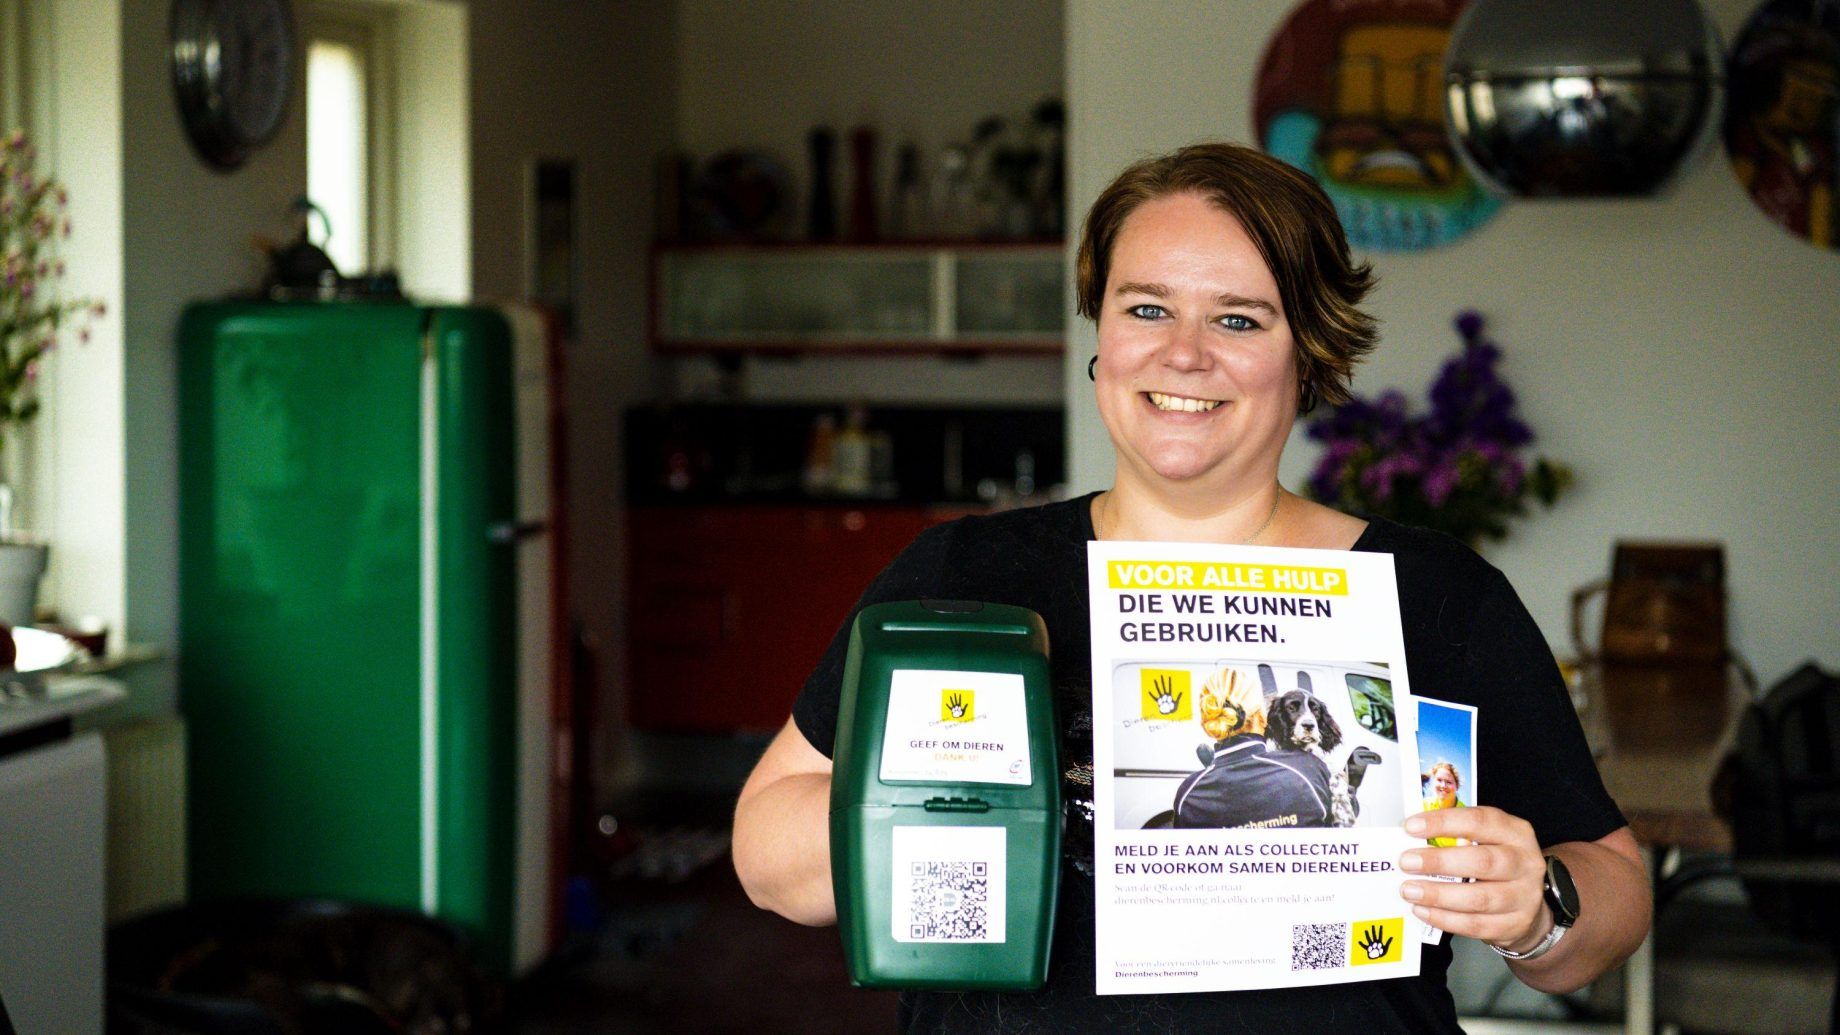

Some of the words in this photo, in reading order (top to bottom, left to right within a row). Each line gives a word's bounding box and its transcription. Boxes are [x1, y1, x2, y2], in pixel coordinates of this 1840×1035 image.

[1115, 564, 1194, 586] VOOR
[1202, 566, 1265, 588] ALLE
[1273, 569, 1340, 591] HULP
[1118, 593, 1163, 613] DIE
[1172, 594, 1215, 614] WE
[1224, 595, 1332, 618] KUNNEN
[1119, 622, 1286, 643] GEBRUIKEN.
[910, 740, 939, 749] GEEF
[942, 741, 960, 750] OM
[963, 741, 1004, 751] DIEREN
[934, 753, 965, 762] DANK
[1222, 814, 1298, 829] scherming
[1114, 845, 1159, 857] MELD
[1163, 845, 1180, 856] JE
[1185, 844, 1219, 856] AAN
[1224, 844, 1254, 856] ALS
[1259, 843, 1359, 856] COLLECTANT
[1114, 863, 1136, 874] EN
[1141, 862, 1223, 874] VOORKOM
[1229, 862, 1286, 874] SAMEN
[1292, 861, 1395, 873] DIERENLEED.
[1115, 970, 1199, 979] Dierenbescherming
